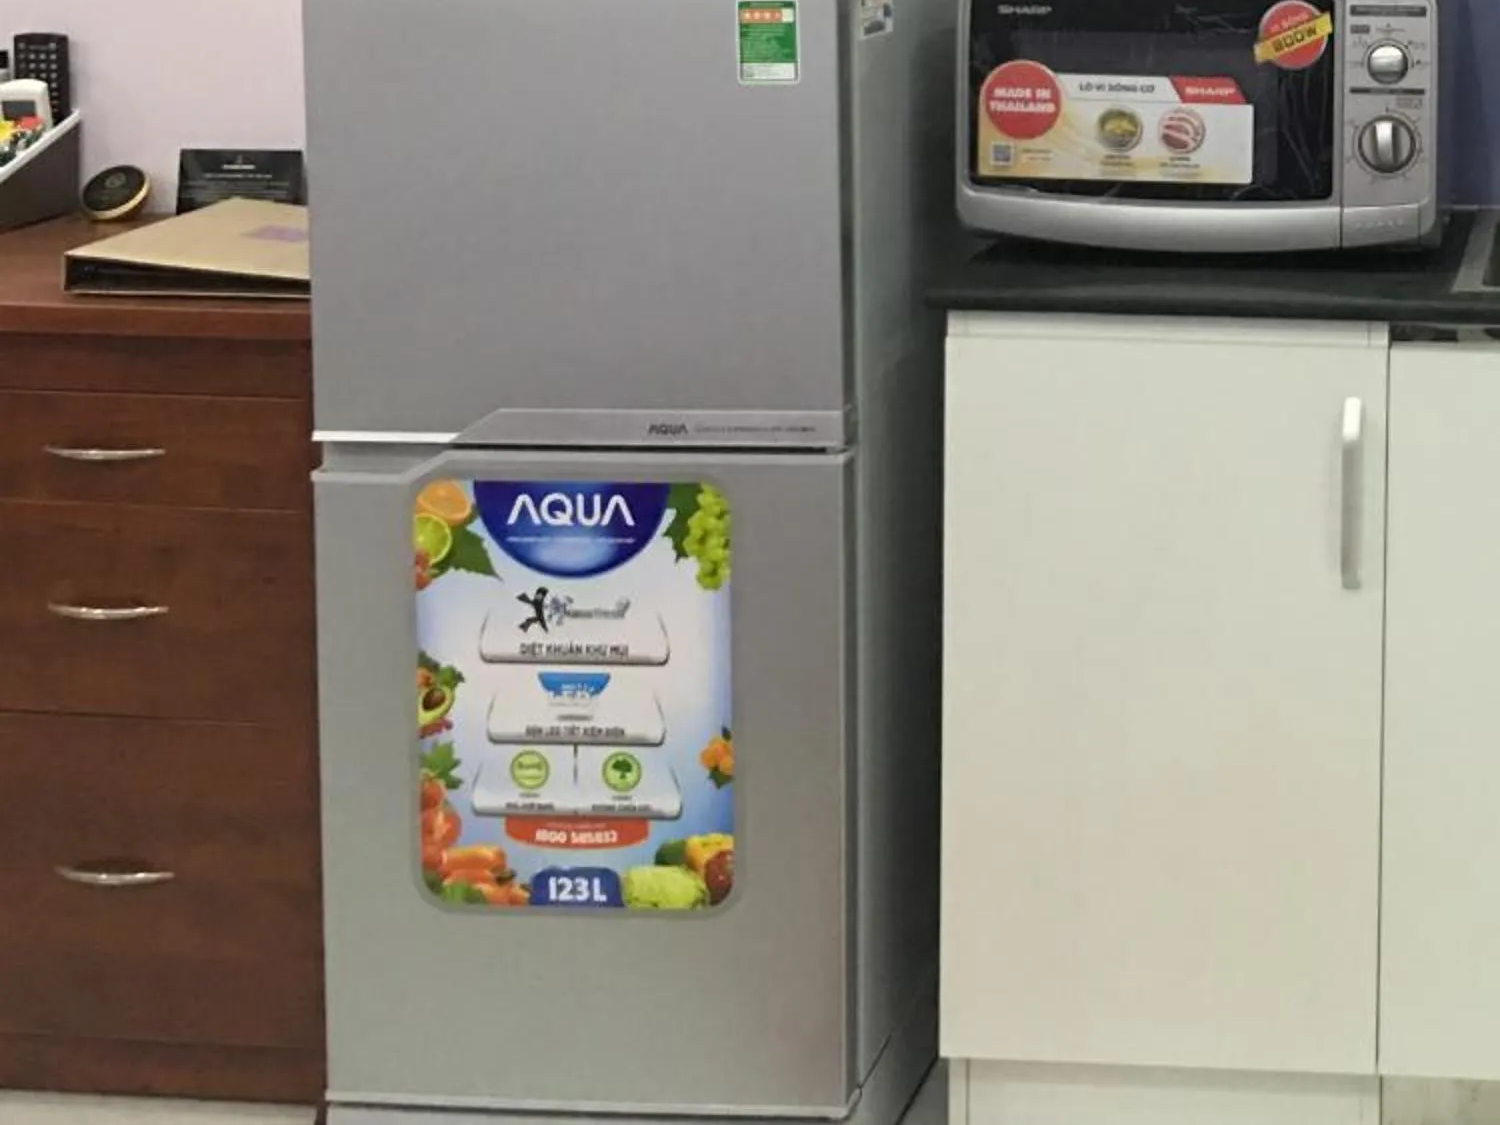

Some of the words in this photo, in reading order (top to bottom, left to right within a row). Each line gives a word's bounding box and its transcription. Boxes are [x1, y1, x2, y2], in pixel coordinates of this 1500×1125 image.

[997, 3, 1053, 16] SHARP
[993, 86, 1031, 100] MADE
[1035, 87, 1052, 100] IN
[1184, 85, 1236, 97] SHARP
[988, 99, 1057, 114] THAILAND
[648, 422, 689, 437] AQUA
[507, 492, 635, 527] AQUA
